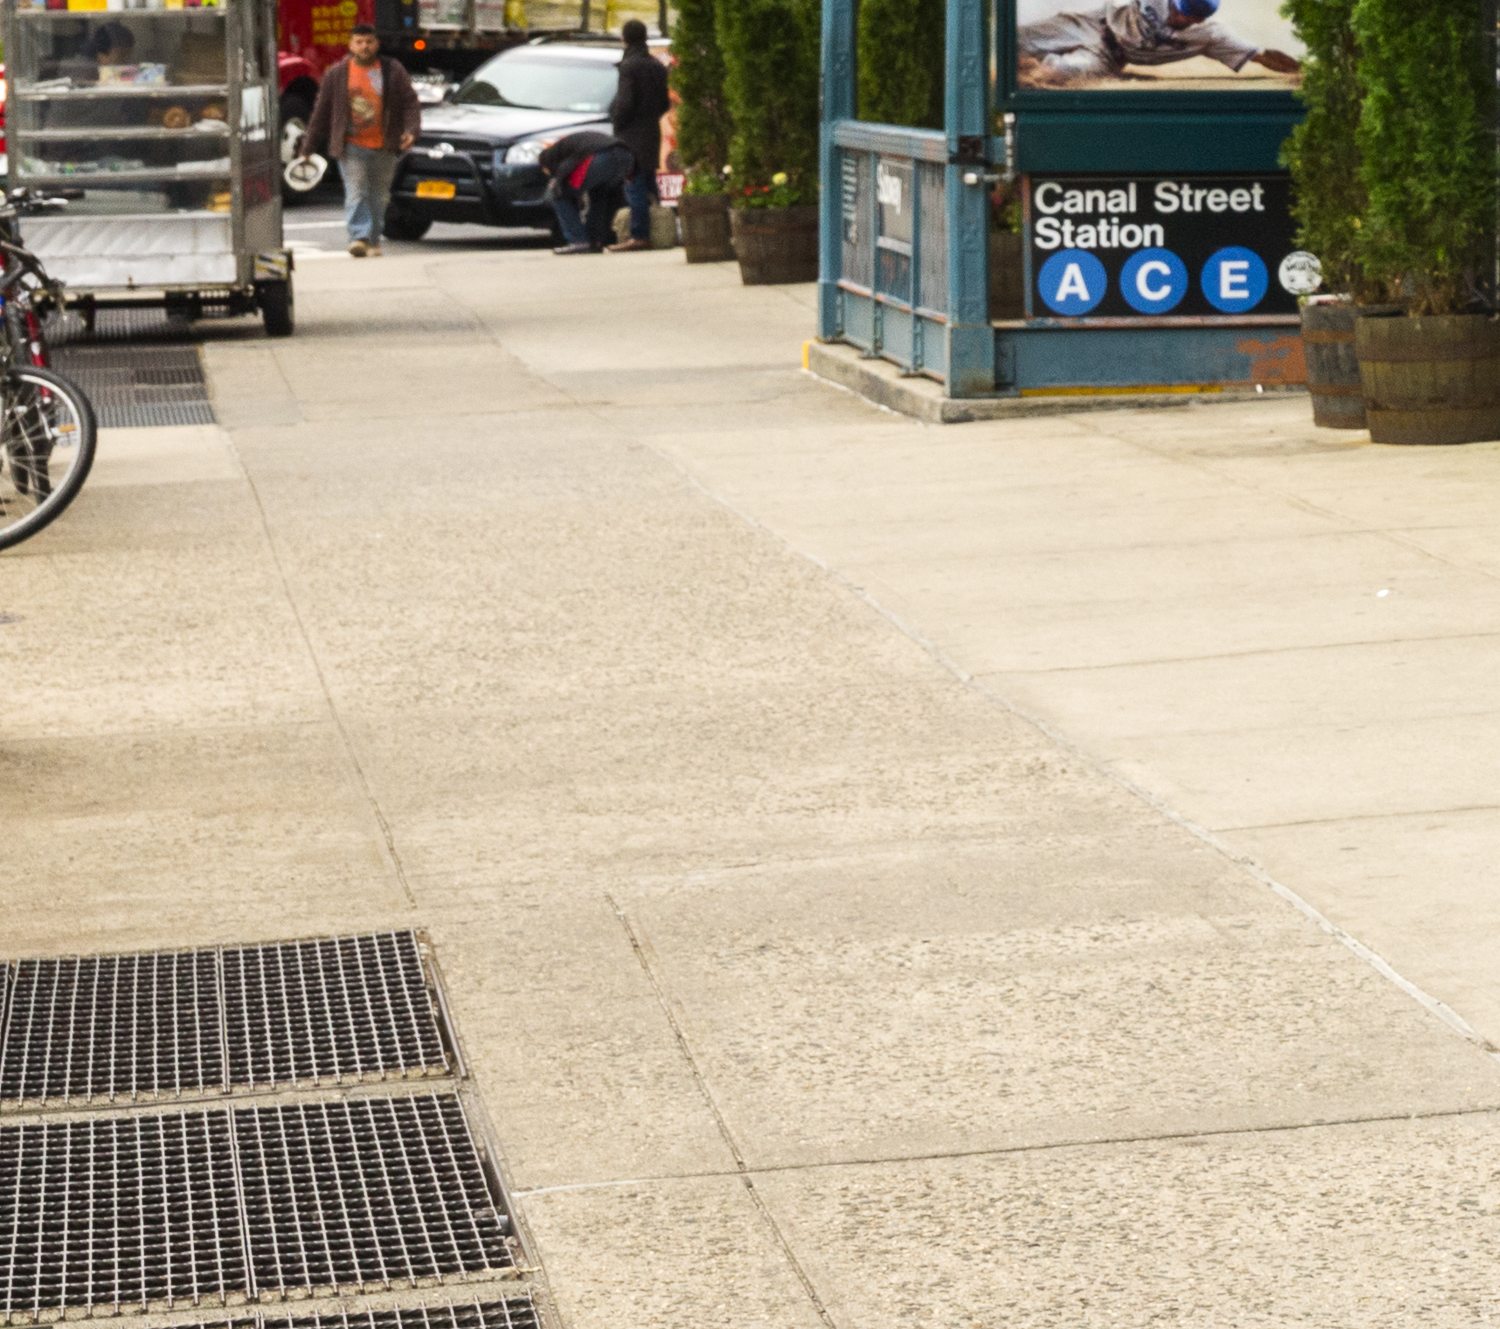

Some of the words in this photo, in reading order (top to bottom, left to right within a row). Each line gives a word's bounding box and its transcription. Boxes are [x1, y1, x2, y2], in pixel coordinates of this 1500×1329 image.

[1034, 182, 1138, 215] Canal
[1153, 181, 1265, 214] Street
[1034, 216, 1165, 250] Station
[1055, 263, 1091, 302] A
[1135, 260, 1172, 301] C
[1219, 260, 1250, 300] E
